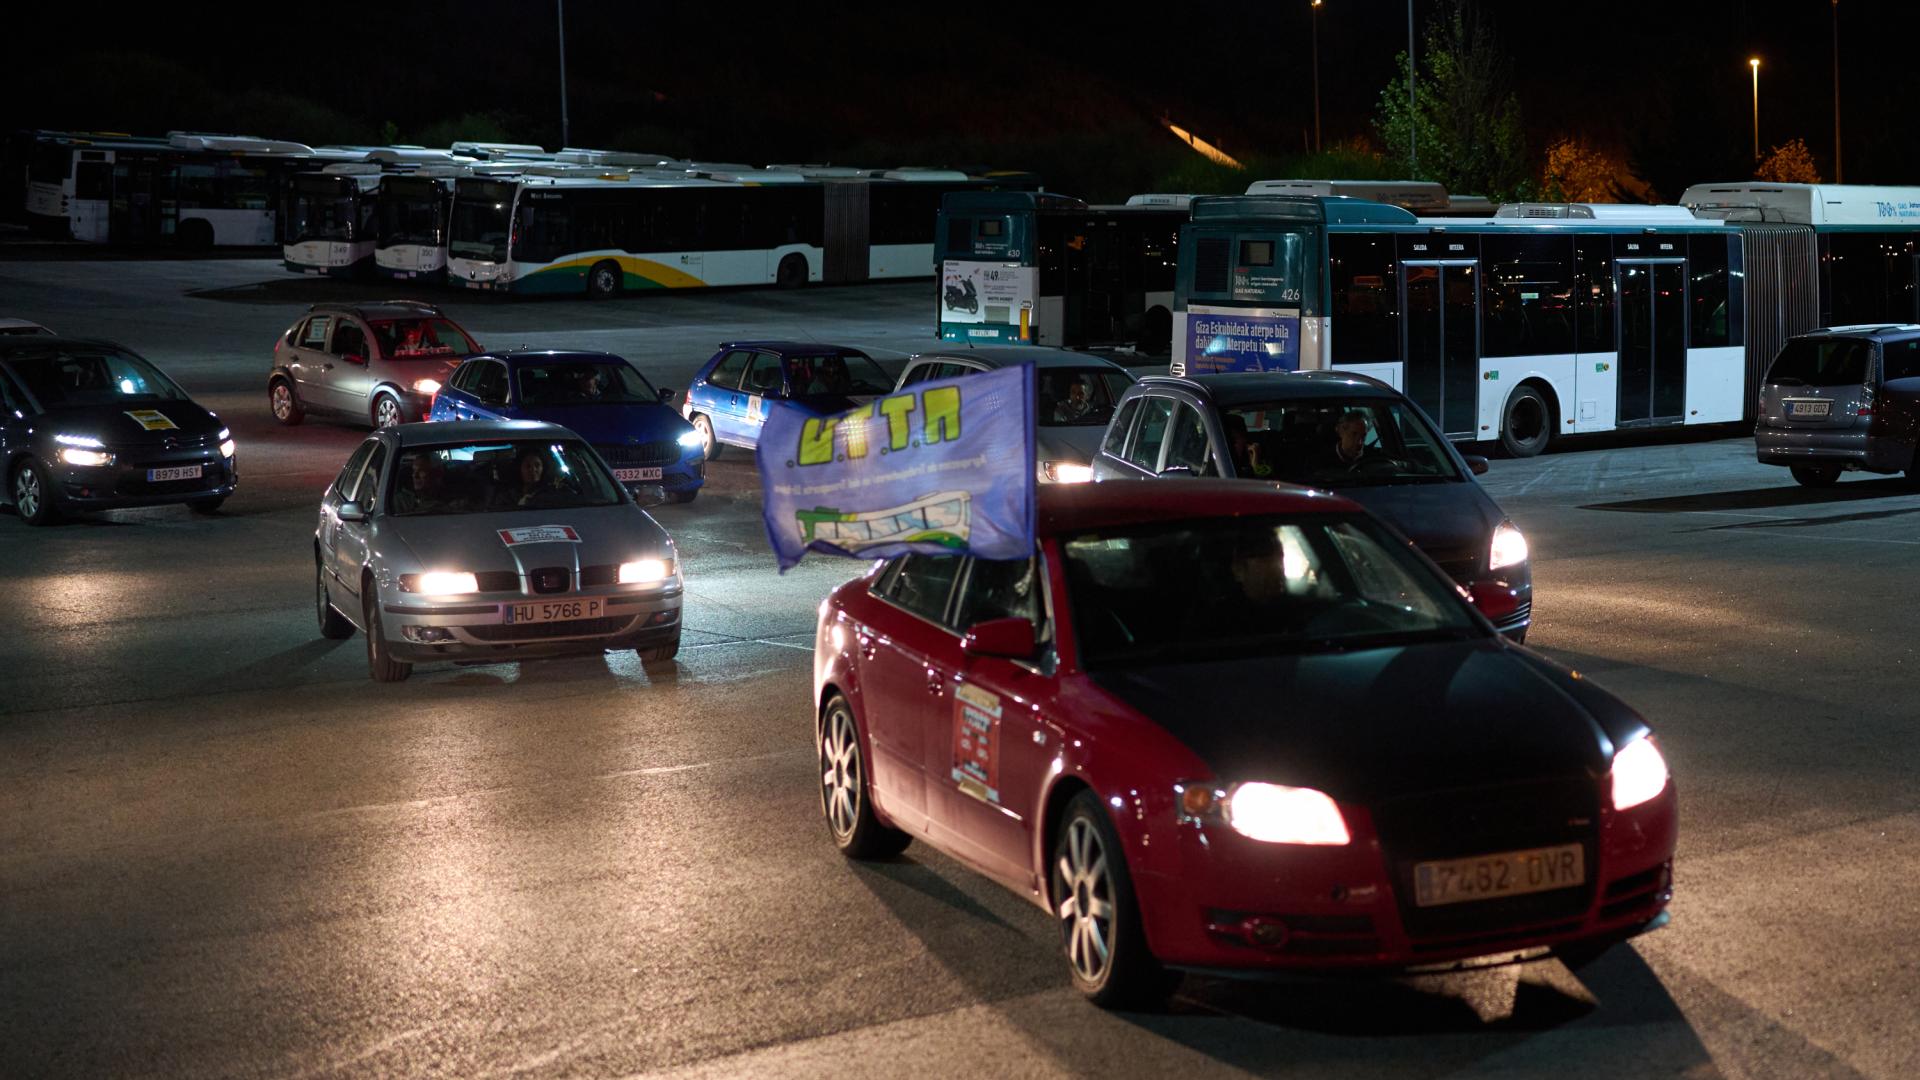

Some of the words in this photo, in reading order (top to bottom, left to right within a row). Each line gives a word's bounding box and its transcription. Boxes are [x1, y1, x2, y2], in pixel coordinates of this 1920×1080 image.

[1281, 288, 1300, 301] 426
[1195, 320, 1210, 334] Giza
[1210, 321, 1249, 337] Eskubideak
[1250, 324, 1274, 340] aterpe
[1274, 324, 1289, 339] bila
[1226, 338, 1258, 355] Aterpetu
[155, 469, 180, 480] 8979
[182, 467, 200, 477] HSY
[615, 470, 640, 480] 6332
[642, 468, 661, 478] MXC
[514, 606, 534, 621] HU
[543, 602, 582, 619] 5766
[589, 601, 599, 616] P
